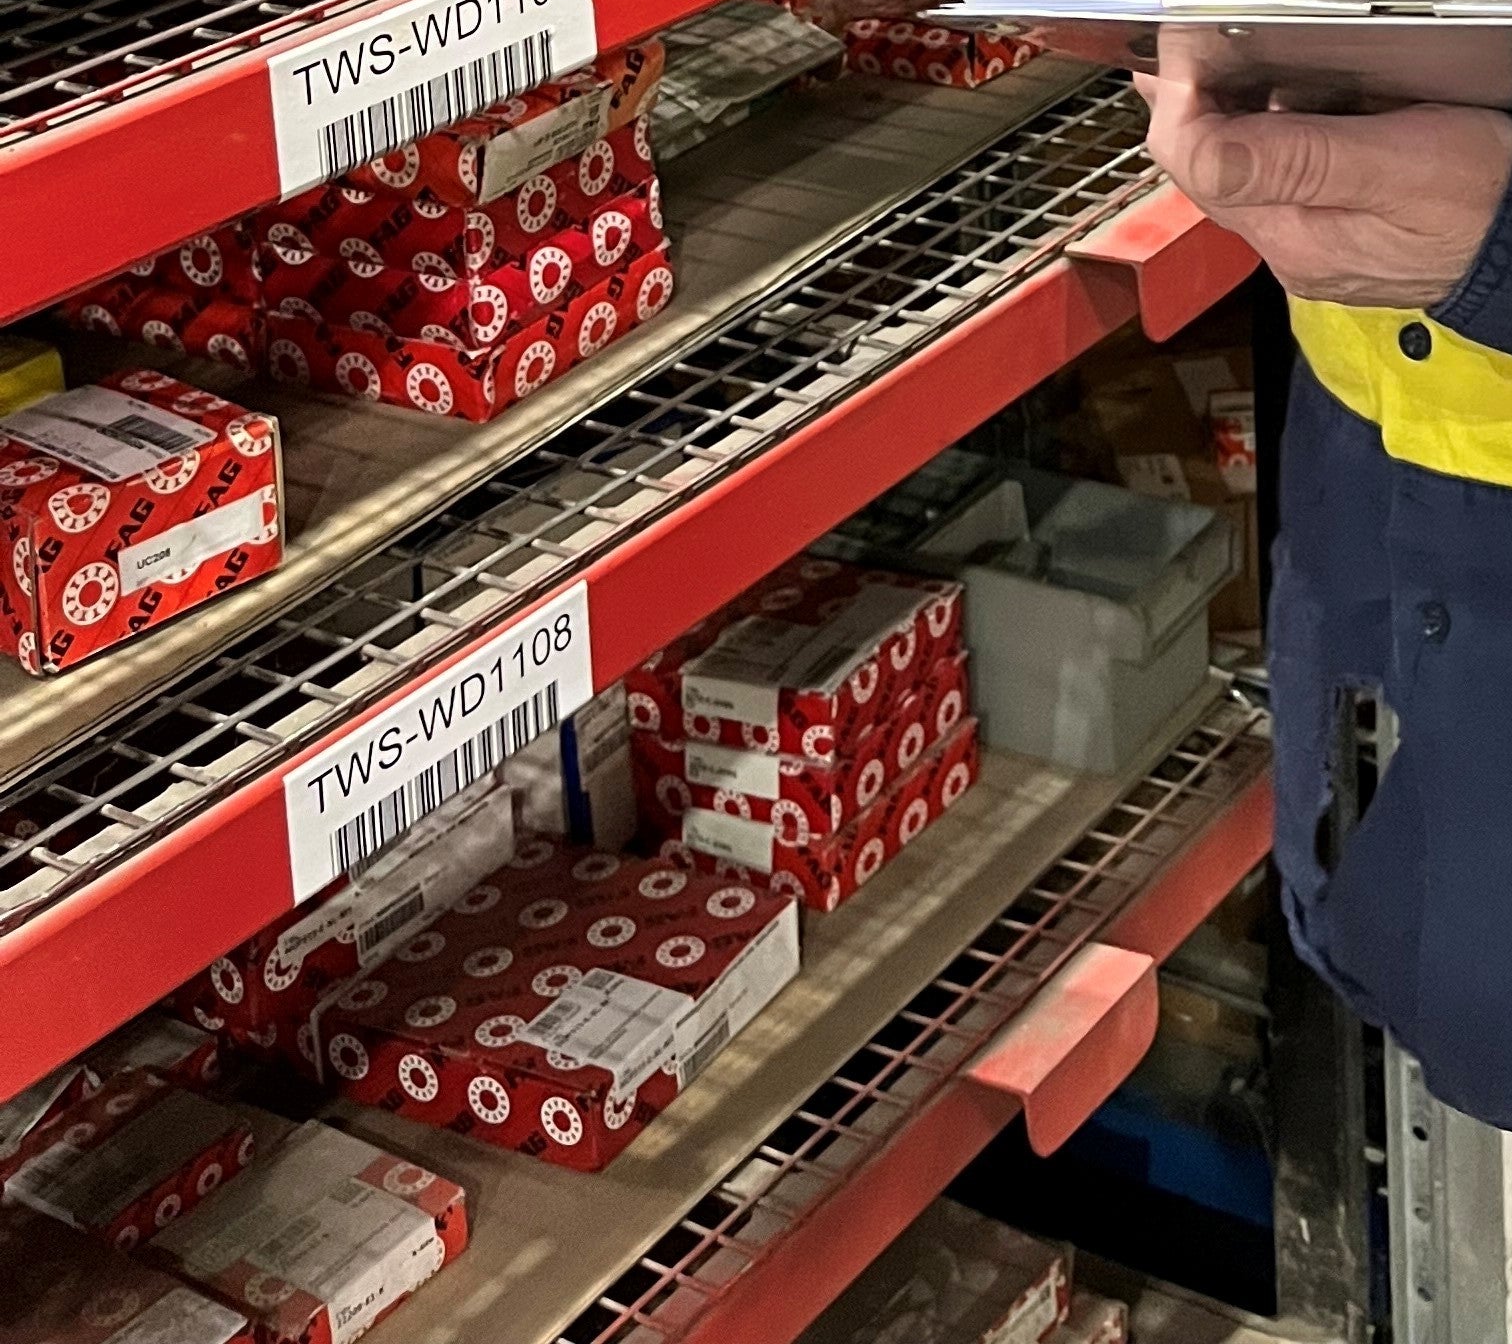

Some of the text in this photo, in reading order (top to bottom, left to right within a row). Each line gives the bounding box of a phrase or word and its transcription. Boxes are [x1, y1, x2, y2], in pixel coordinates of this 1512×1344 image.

[215, 548, 249, 593] AG
[130, 588, 162, 634] AG
[307, 613, 572, 813] TWS-WD1108
